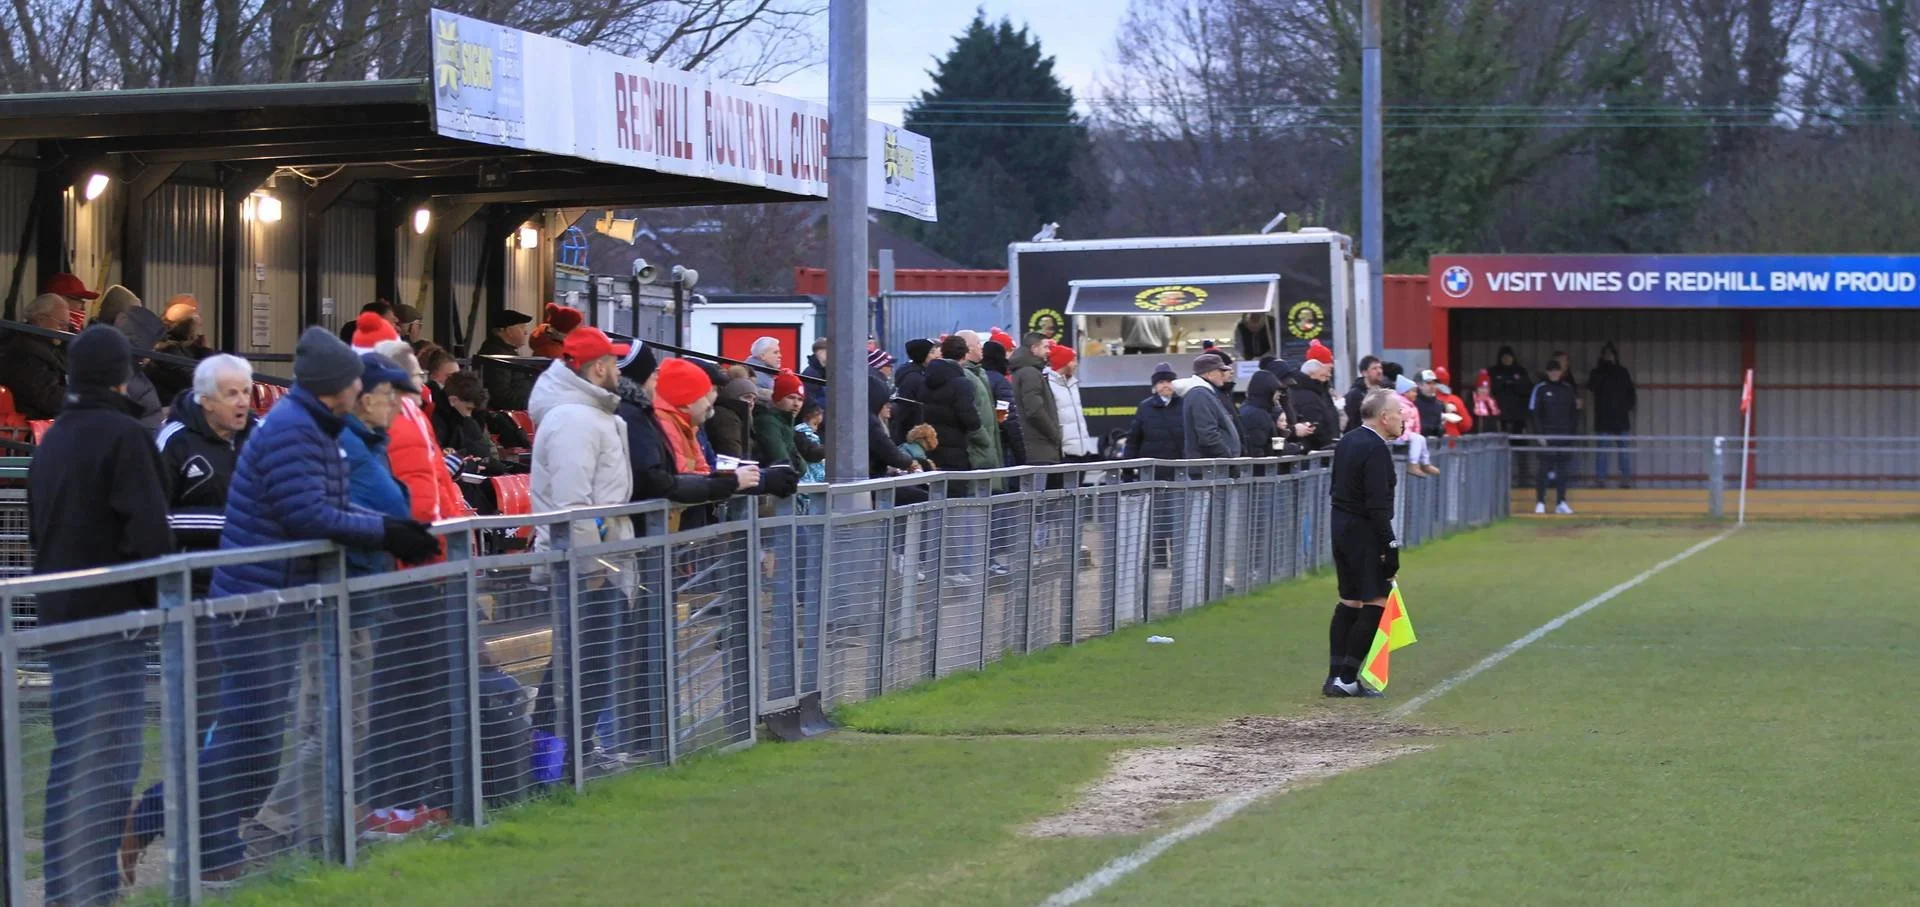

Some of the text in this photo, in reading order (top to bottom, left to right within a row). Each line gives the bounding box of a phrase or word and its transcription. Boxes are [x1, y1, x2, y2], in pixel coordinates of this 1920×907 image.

[614, 71, 693, 160] REDHILL
[704, 90, 783, 176] FOOTBALL
[790, 111, 828, 182] CLUB
[1486, 271, 1547, 292] VISIT
[1551, 271, 1622, 292] VINES
[1627, 271, 1660, 292] OF
[1665, 271, 1766, 292] REDHILL
[1770, 271, 1830, 292] BMW
[1835, 271, 1916, 292] PROUD
